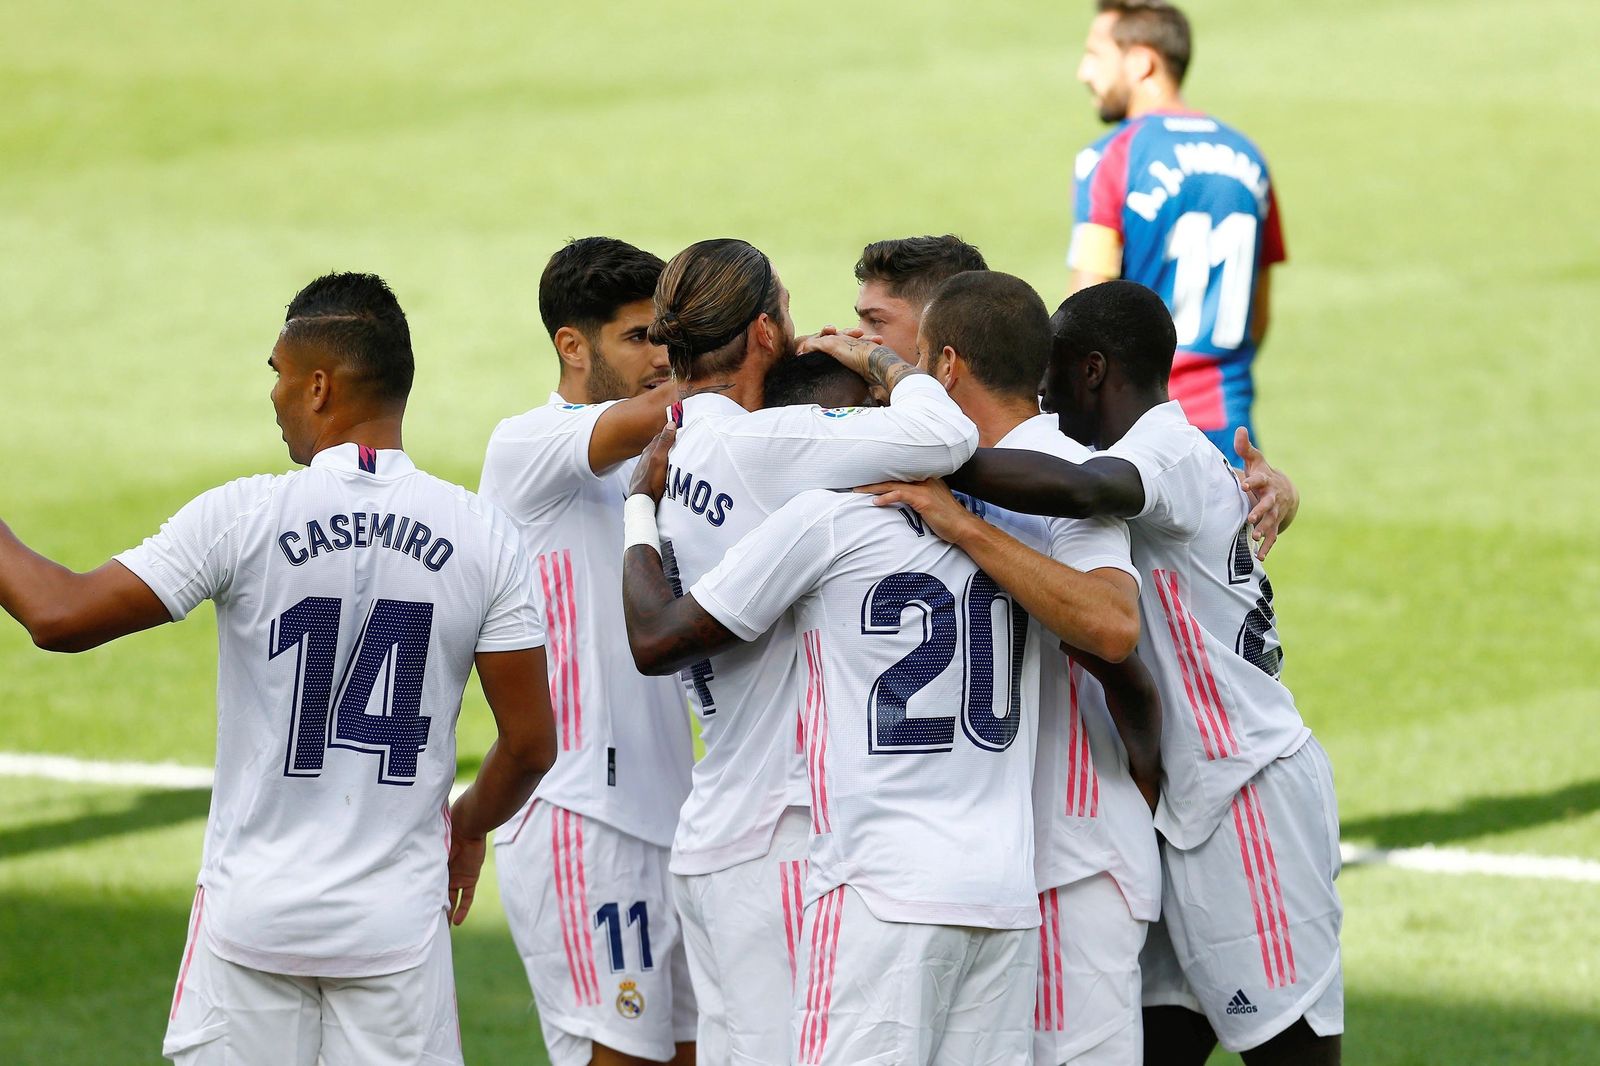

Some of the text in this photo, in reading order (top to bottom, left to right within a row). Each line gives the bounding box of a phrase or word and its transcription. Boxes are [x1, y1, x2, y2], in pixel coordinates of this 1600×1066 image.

[1166, 211, 1257, 350] 11
[278, 512, 454, 573] CASEMIRO
[269, 597, 434, 786] 14
[861, 571, 1029, 755] 20
[593, 901, 654, 974] 11
[1226, 1005, 1258, 1015] adidas
